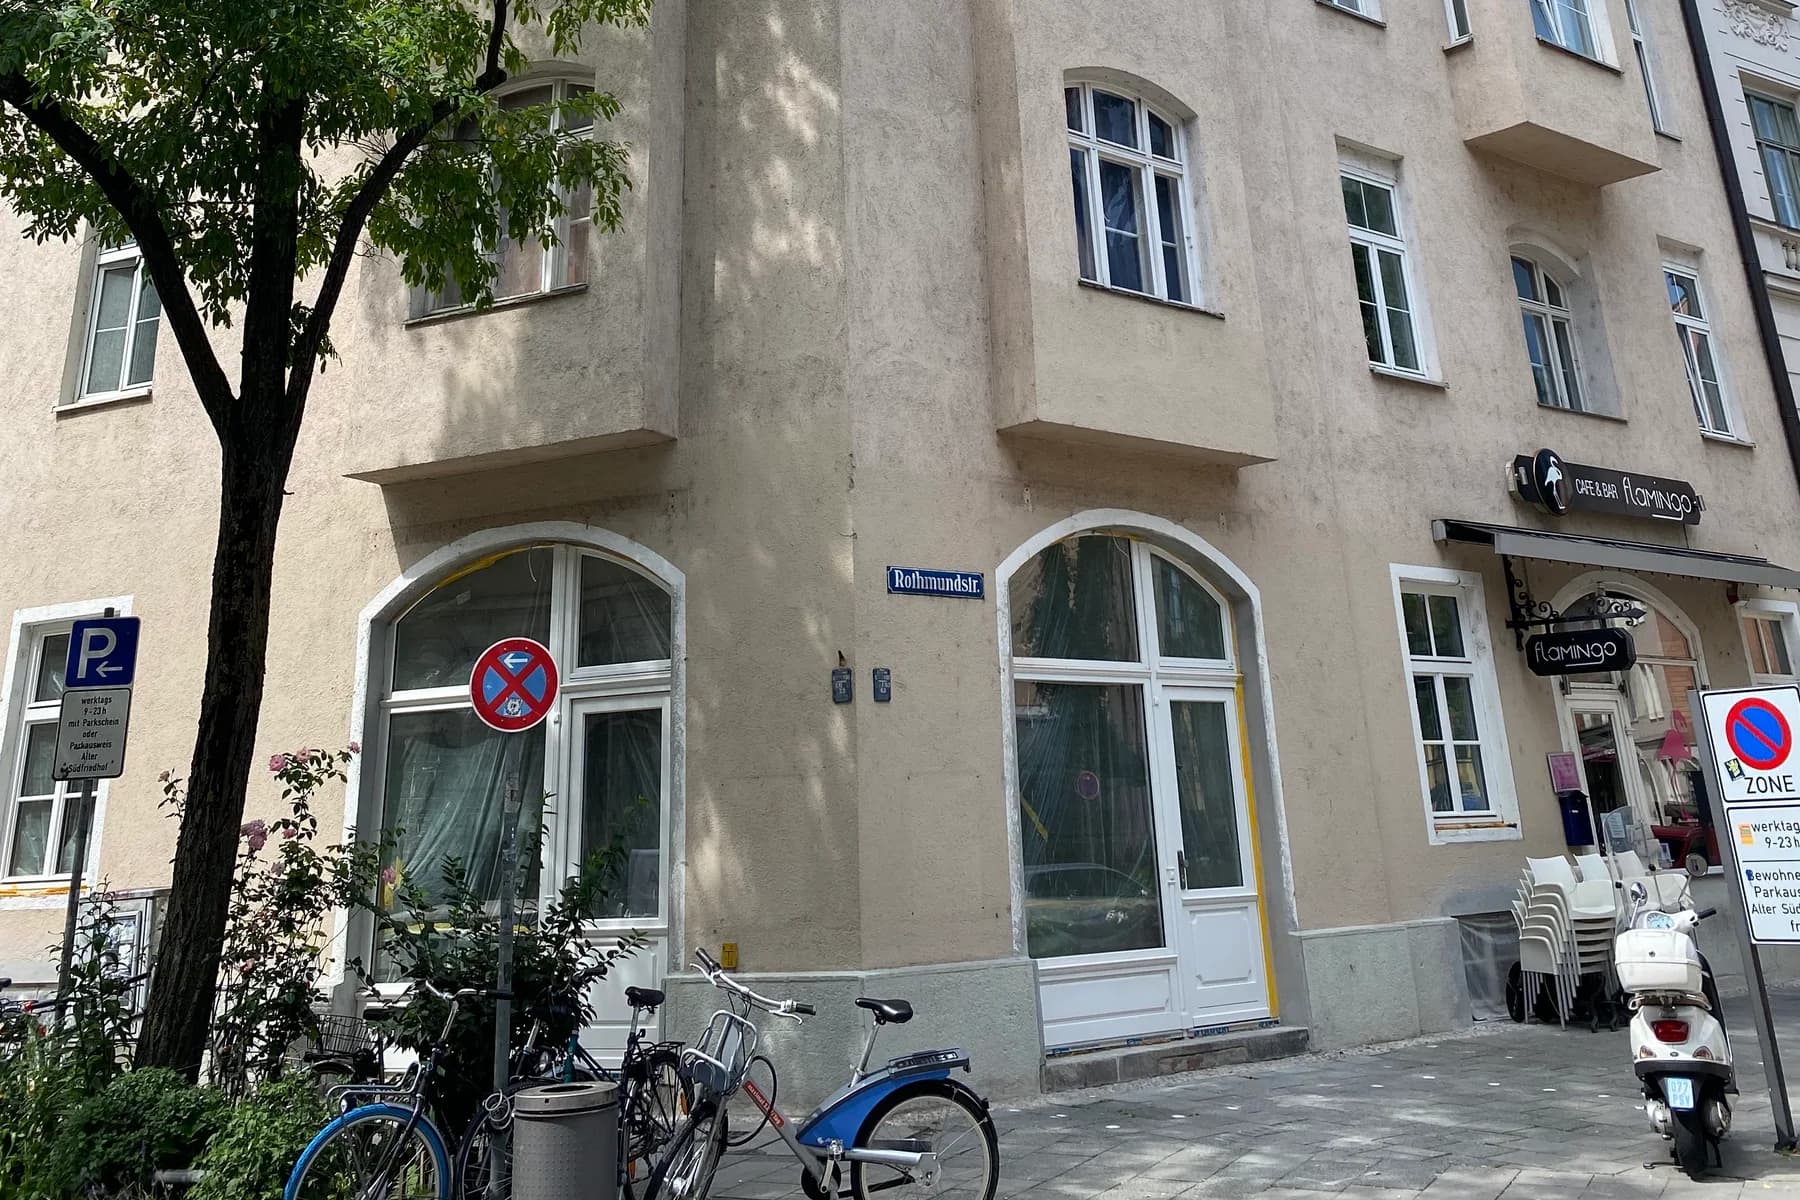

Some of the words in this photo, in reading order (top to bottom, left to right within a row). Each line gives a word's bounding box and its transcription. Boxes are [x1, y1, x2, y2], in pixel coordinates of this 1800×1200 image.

[894, 569, 980, 593] Rothmundstr.
[77, 628, 117, 679] P
[81, 695, 113, 706] werktags
[68, 719, 80, 728] mit
[82, 718, 119, 727] Parkschein
[82, 730, 98, 738] oder
[70, 741, 112, 750] Parkausweis
[81, 751, 98, 760] Alter
[1744, 775, 1796, 794] ZONE
[1751, 903, 1777, 915] Alter
